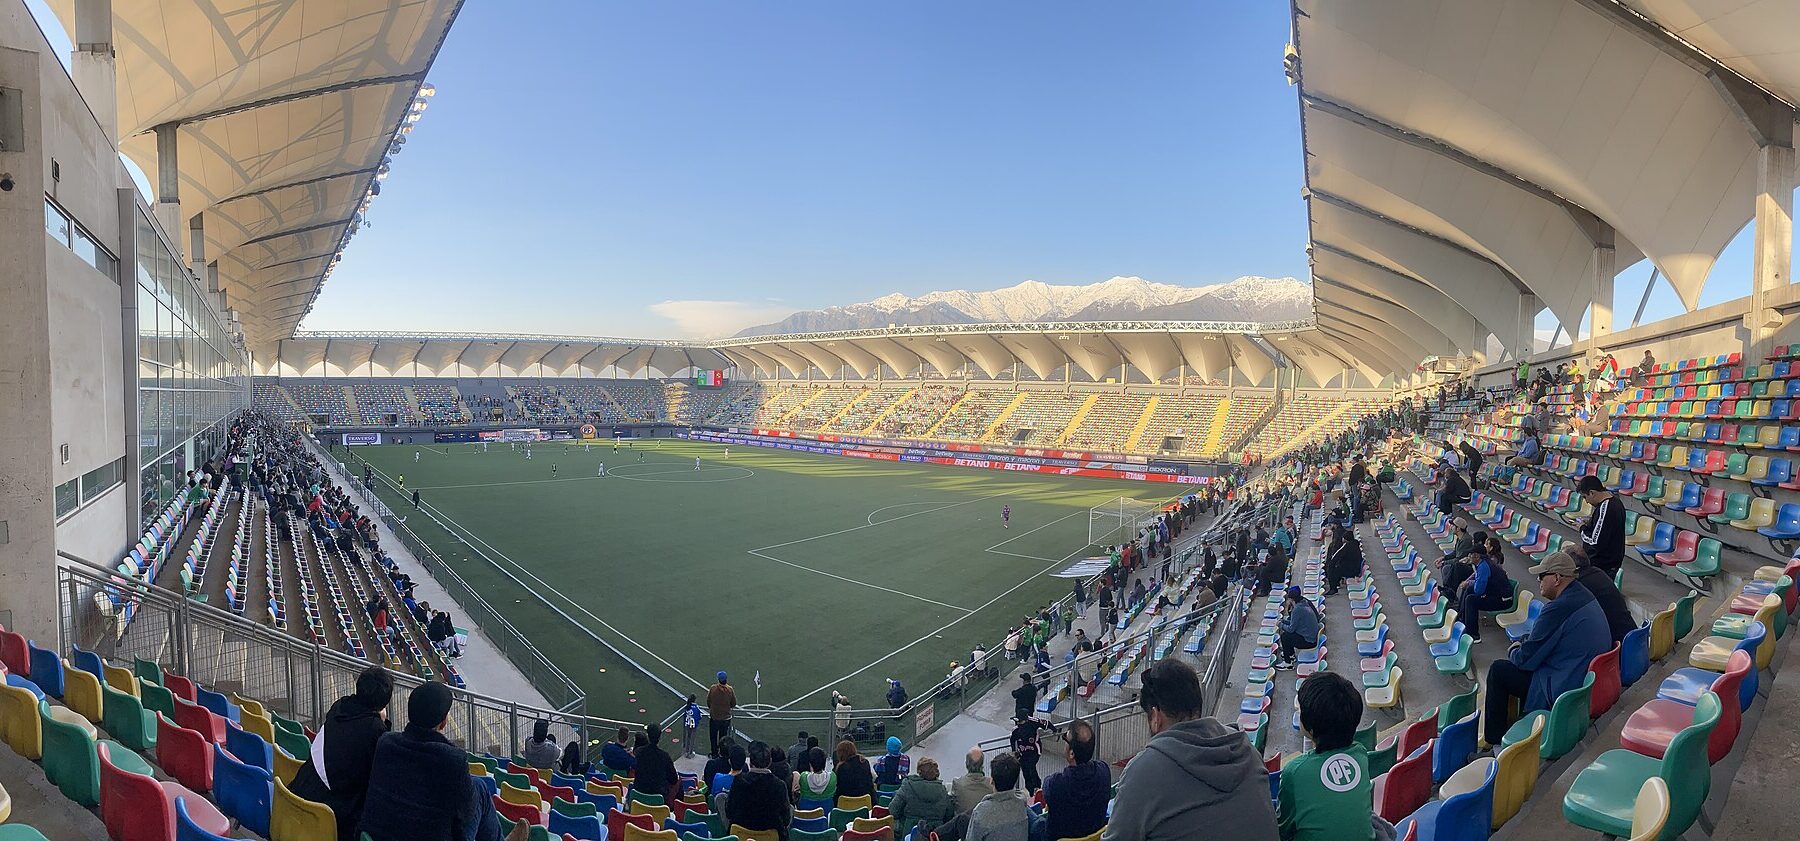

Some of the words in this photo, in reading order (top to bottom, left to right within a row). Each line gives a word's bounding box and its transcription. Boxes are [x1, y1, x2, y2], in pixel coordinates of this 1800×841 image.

[954, 458, 990, 468] BETANO
[1177, 475, 1209, 485] BETANO
[1328, 759, 1352, 785] PF
